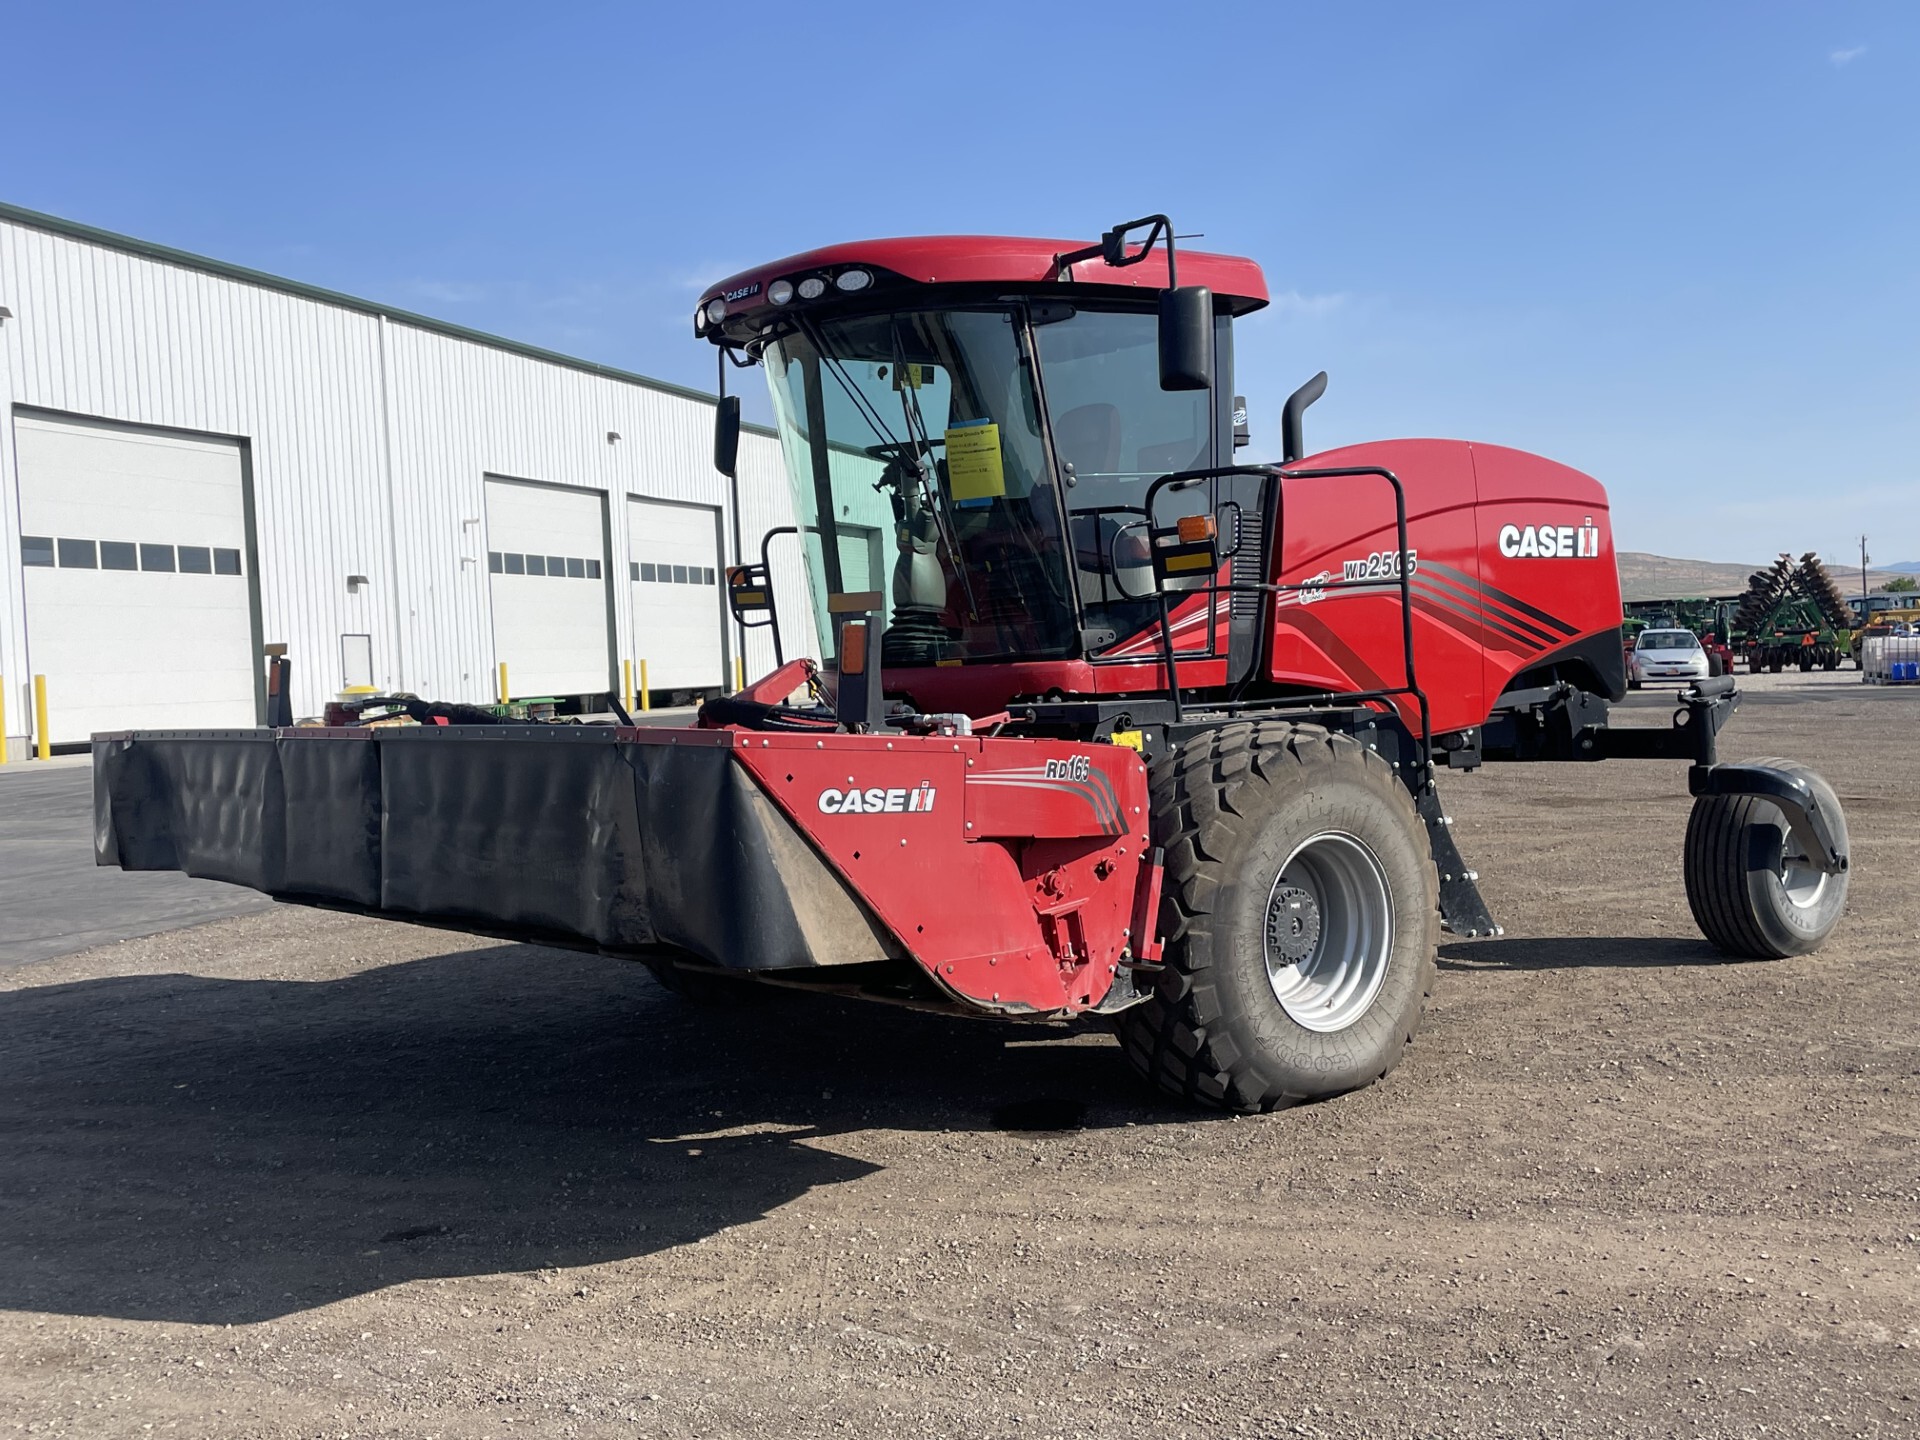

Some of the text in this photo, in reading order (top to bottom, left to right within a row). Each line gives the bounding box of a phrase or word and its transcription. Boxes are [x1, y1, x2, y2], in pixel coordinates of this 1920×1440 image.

[726, 287, 749, 302] CASE
[1499, 524, 1574, 558] CASE
[1045, 755, 1090, 782] RD165
[818, 788, 906, 813] CASE
